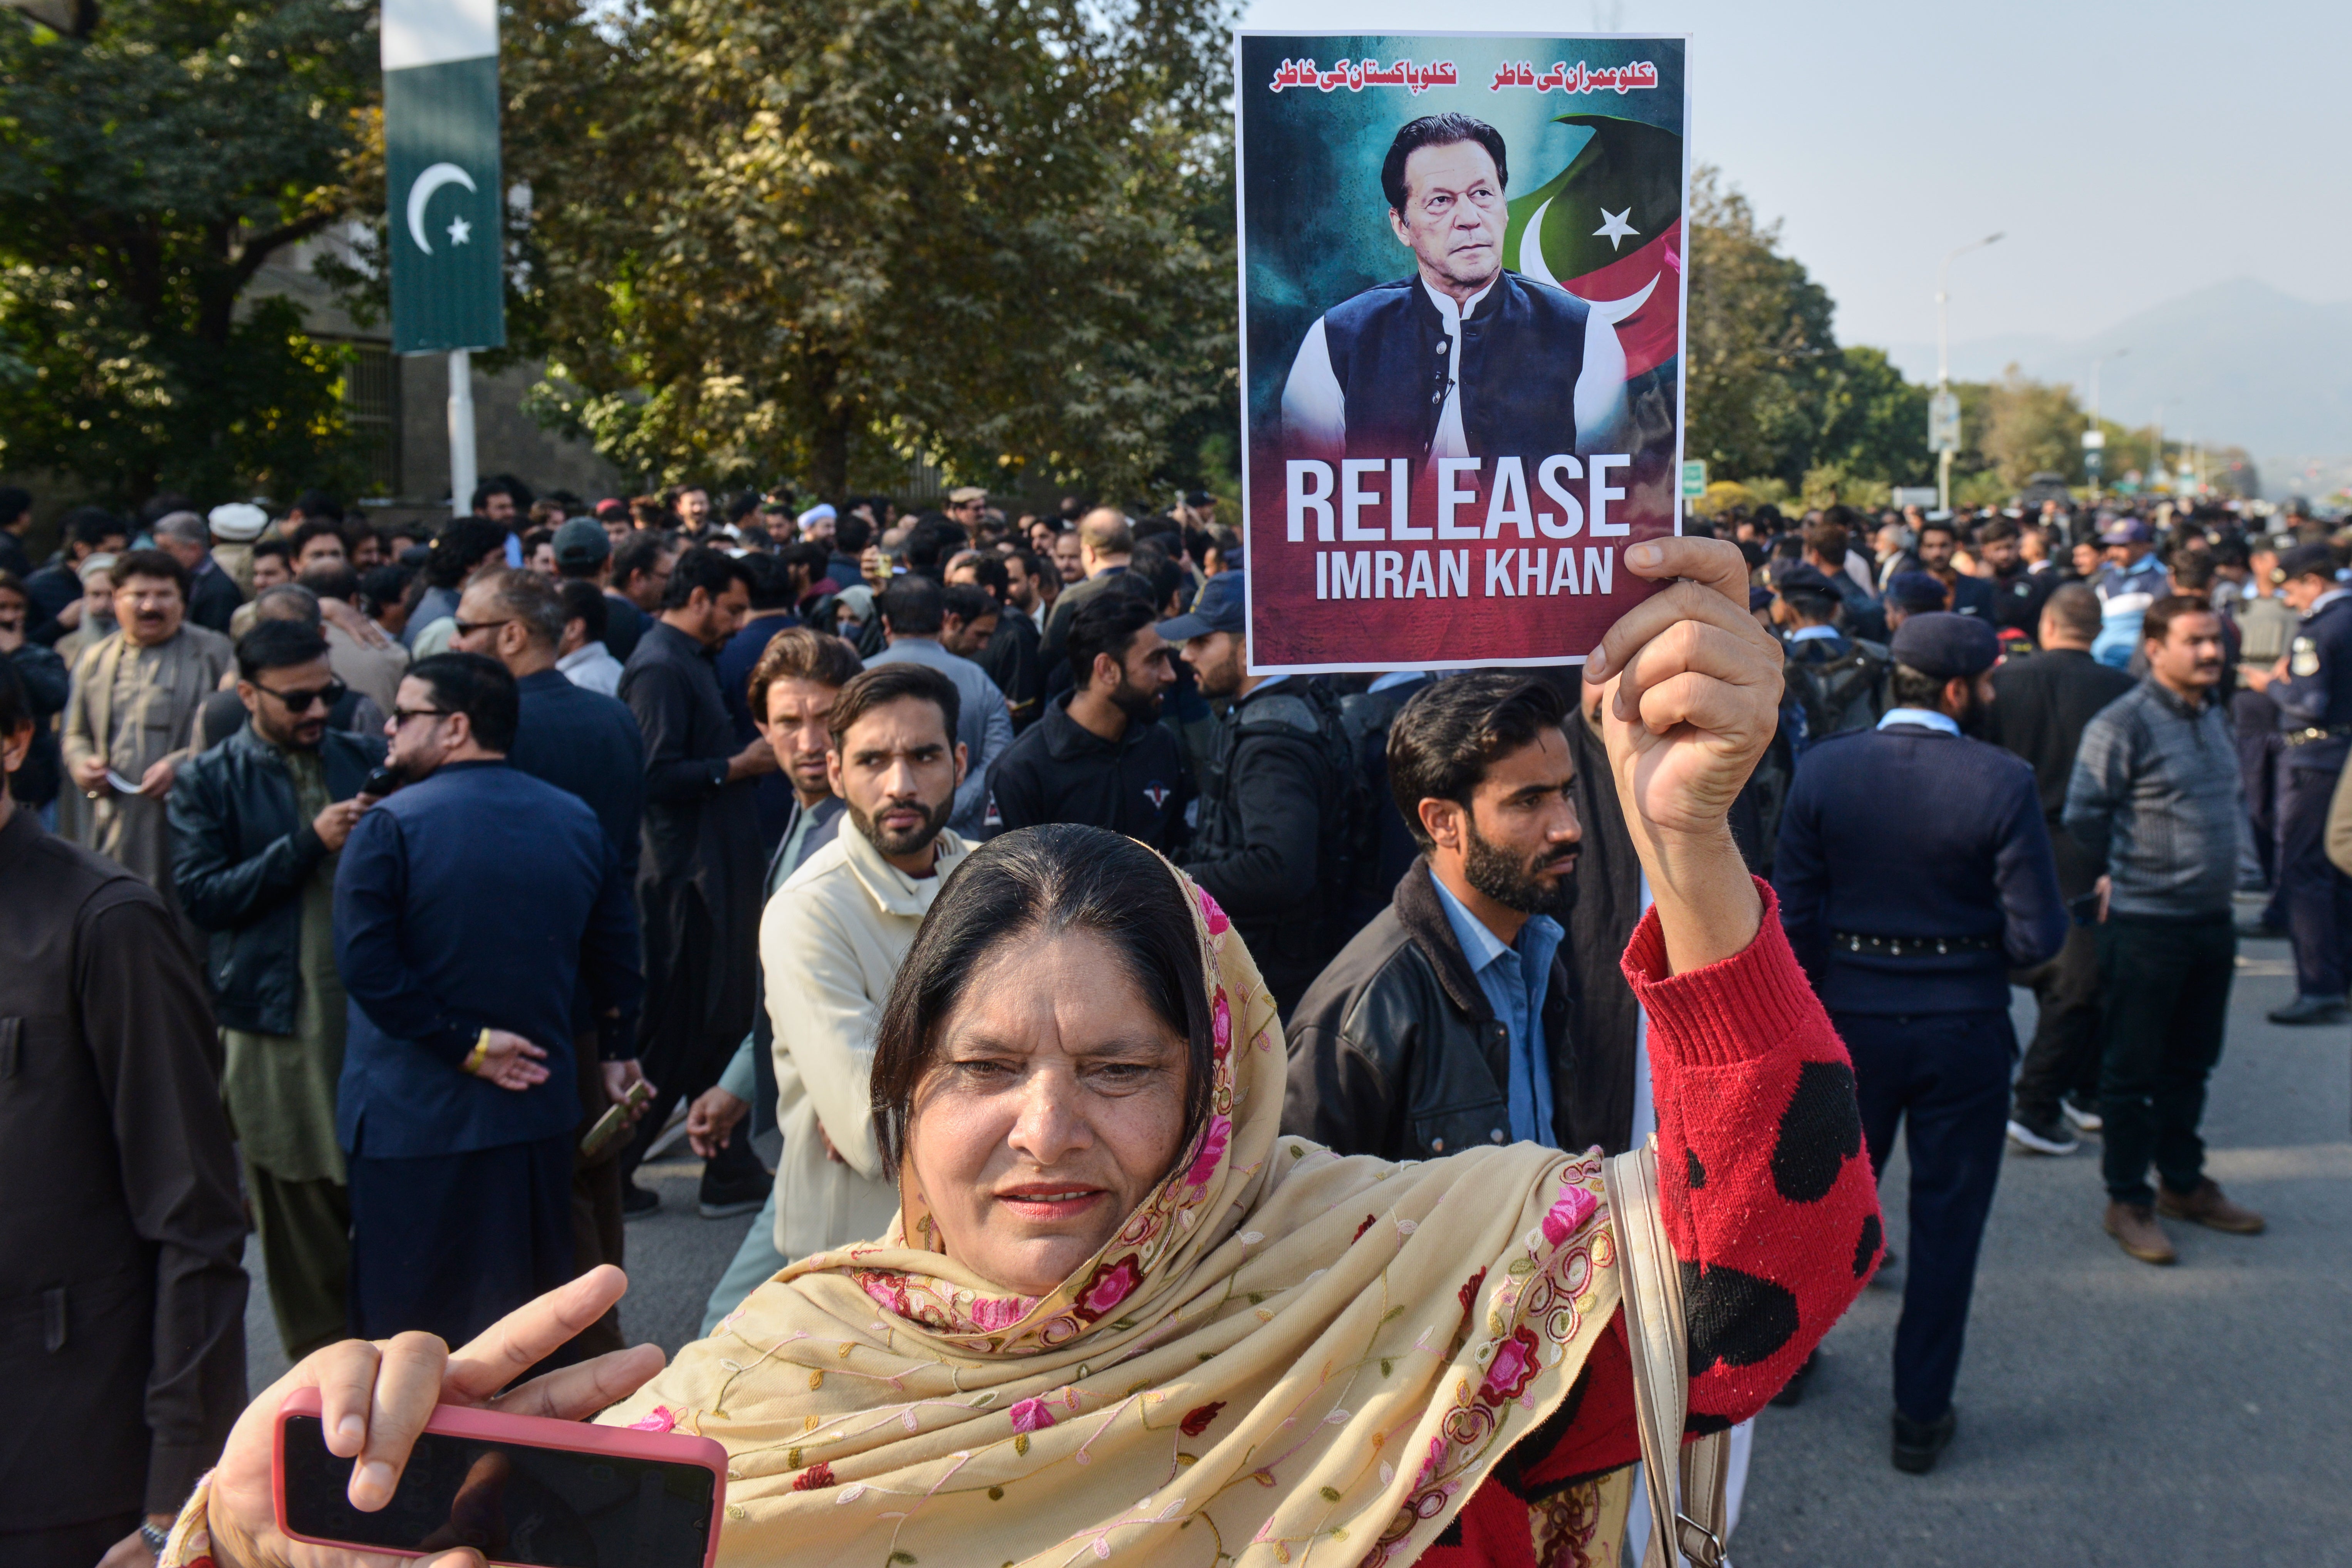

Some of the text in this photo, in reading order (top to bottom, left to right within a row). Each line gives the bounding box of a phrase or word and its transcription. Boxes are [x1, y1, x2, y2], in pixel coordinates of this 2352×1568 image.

[1272, 61, 1317, 90] خاطر
[1350, 61, 1419, 94] پاکستان
[1490, 62, 1535, 91] خاطر
[1565, 63, 1617, 92] عمران
[1287, 454, 1630, 542] RELEASE
[1317, 547, 1613, 599] IMRAN KHAN
